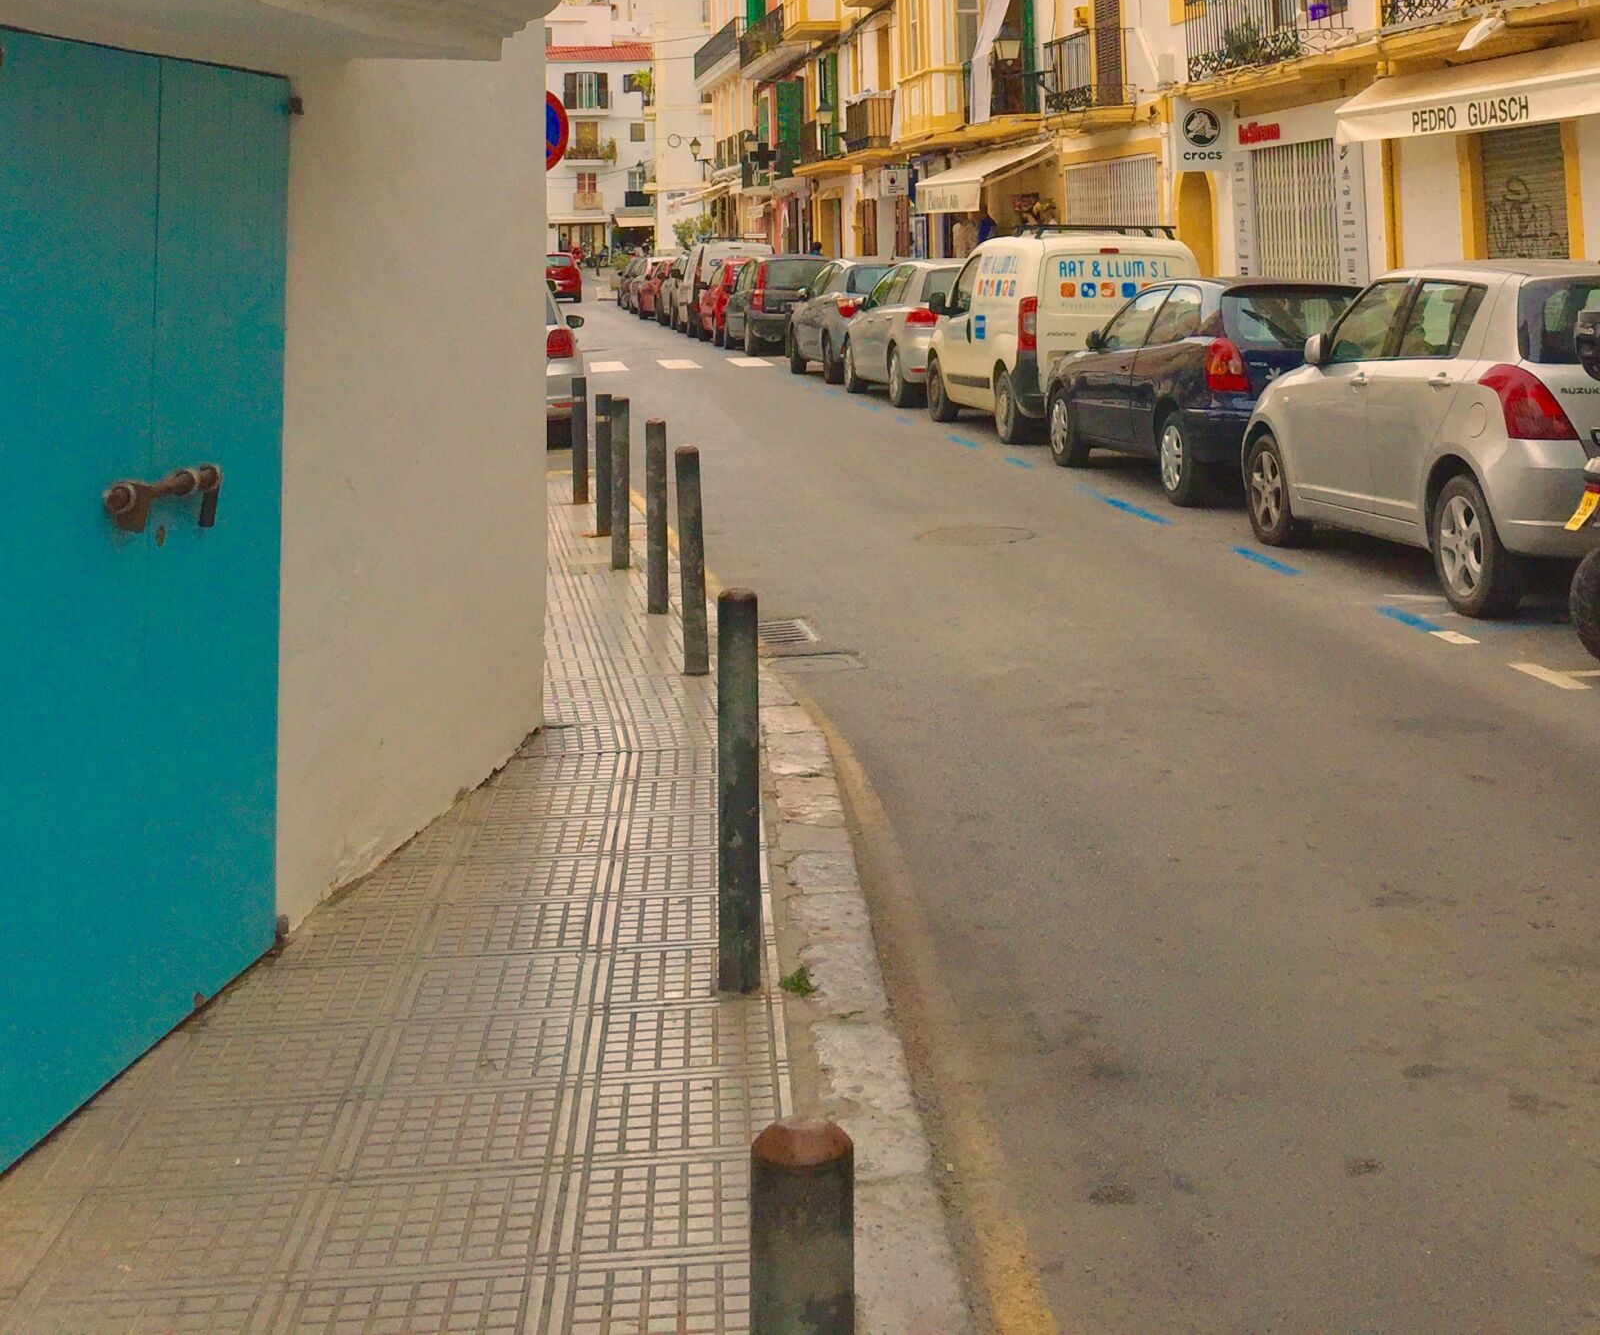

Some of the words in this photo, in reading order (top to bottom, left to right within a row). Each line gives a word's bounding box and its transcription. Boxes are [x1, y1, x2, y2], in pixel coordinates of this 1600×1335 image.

[1411, 105, 1457, 133] PEDRO
[1467, 95, 1529, 127] GUASCH
[1183, 151, 1223, 161] crocs
[1059, 260, 1085, 277] ART
[1091, 260, 1102, 277] &
[1107, 260, 1145, 277] LLUM
